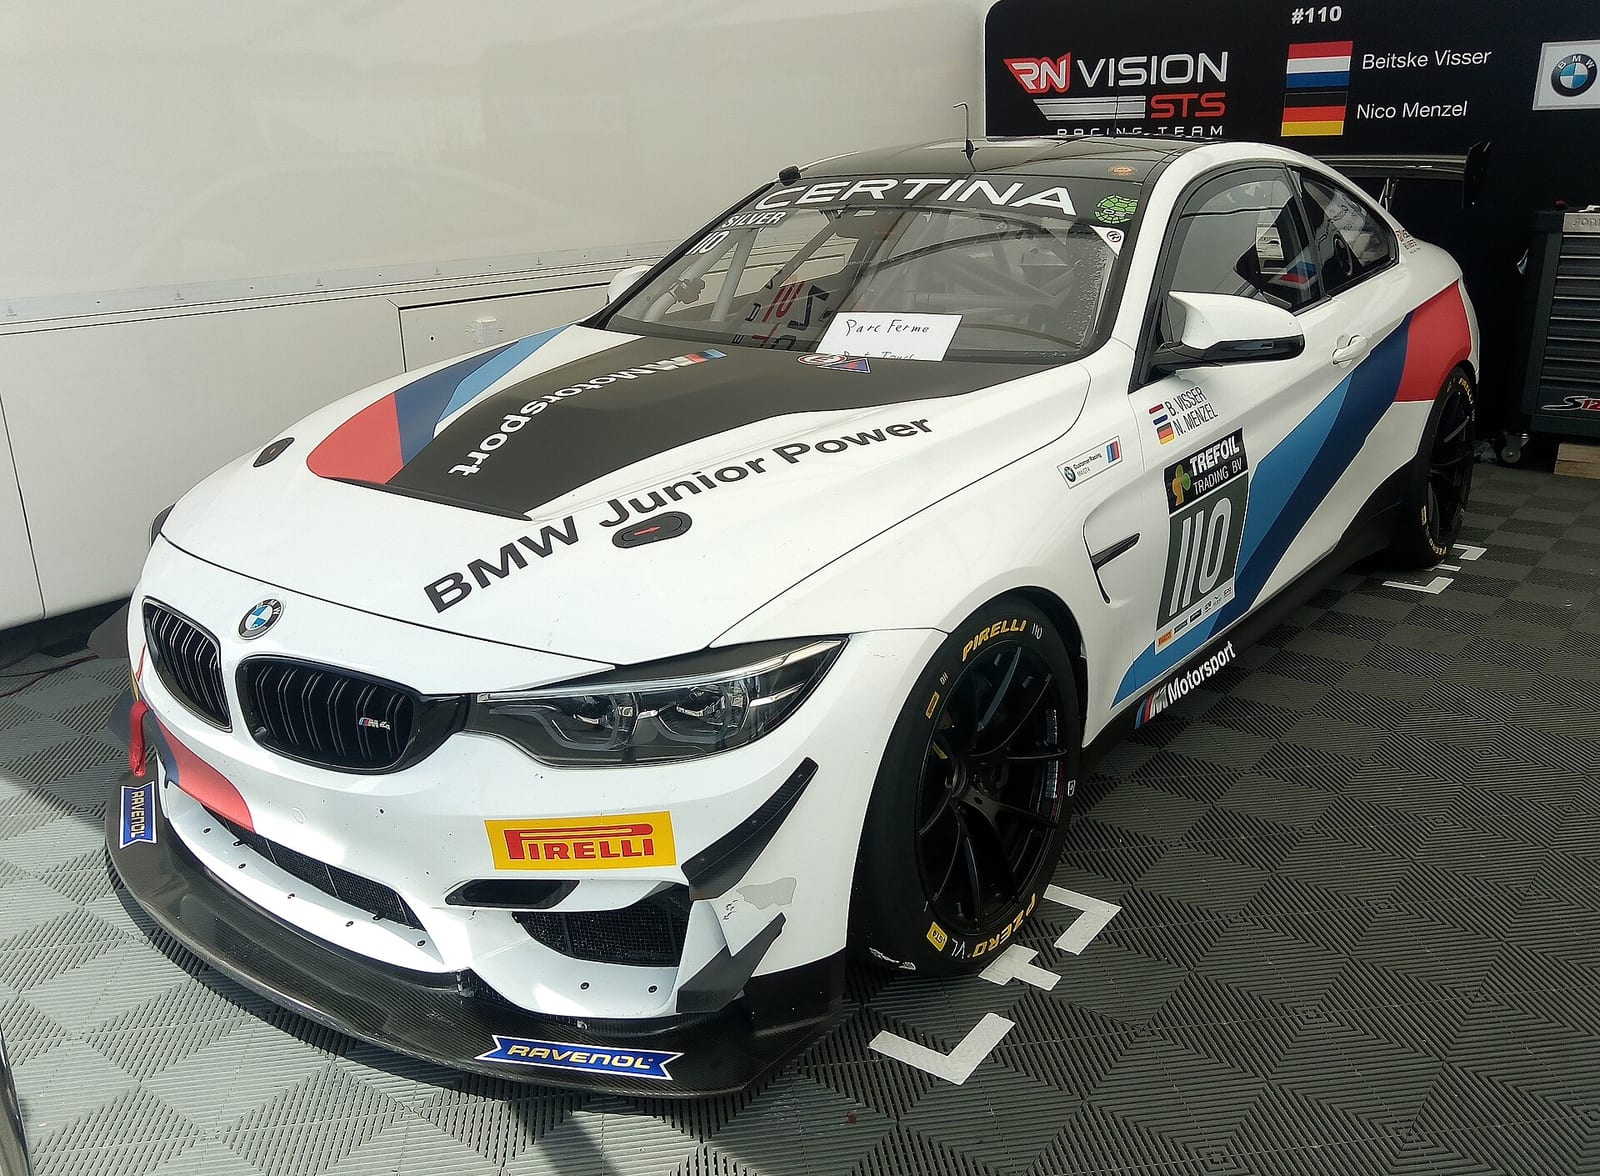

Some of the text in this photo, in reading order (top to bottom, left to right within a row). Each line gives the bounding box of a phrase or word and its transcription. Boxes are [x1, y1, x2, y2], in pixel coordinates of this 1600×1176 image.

[1291, 6, 1342, 24] #110
[1077, 51, 1228, 88] VISION
[1362, 49, 1492, 69] Beitske Visser
[1557, 55, 1595, 70] BMW
[1151, 92, 1226, 119] STS
[1356, 101, 1468, 119] Nico Menzel
[1157, 125, 1224, 136] TEAM
[755, 178, 1077, 217] CERTINA
[721, 211, 787, 229] SILVER
[685, 230, 730, 255] 110
[1164, 386, 1208, 417] B. VISSER
[1173, 402, 1219, 436] N. MENZEL
[449, 367, 658, 476] Motorsport
[1189, 435, 1240, 477] TREFOIL
[1192, 456, 1243, 496] TRADING BV
[424, 416, 934, 613] BMW Junior Power
[1168, 497, 1232, 617] 110
[961, 618, 1028, 662] PIRELLI
[1166, 640, 1236, 705] Motorsport
[130, 790, 146, 838] RAVENOL
[504, 824, 654, 860] PIRELLI
[972, 909, 1026, 958] ZERO
[507, 1045, 651, 1069] RAVENOL
